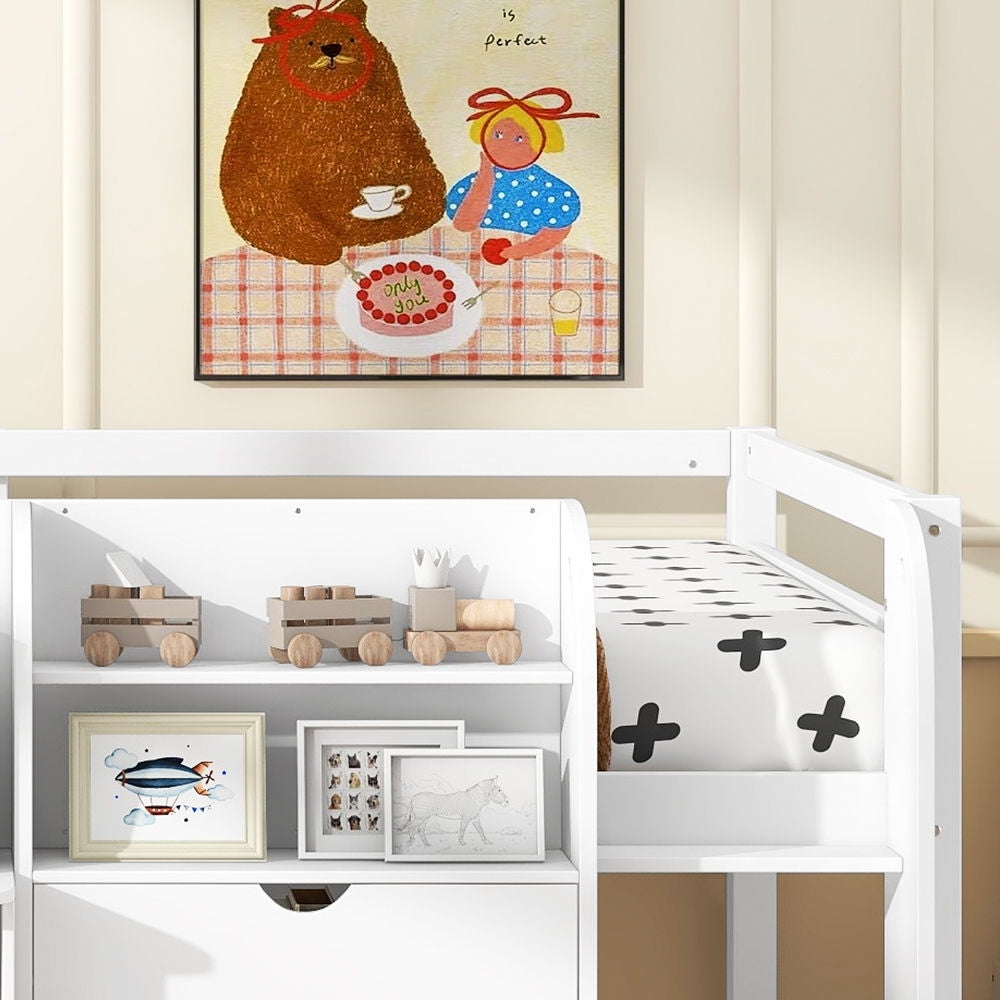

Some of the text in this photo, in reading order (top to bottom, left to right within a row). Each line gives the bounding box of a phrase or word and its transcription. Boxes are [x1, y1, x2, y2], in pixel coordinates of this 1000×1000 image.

[502, 8, 516, 22] is
[384, 275, 421, 297] only
[395, 295, 429, 314] you
